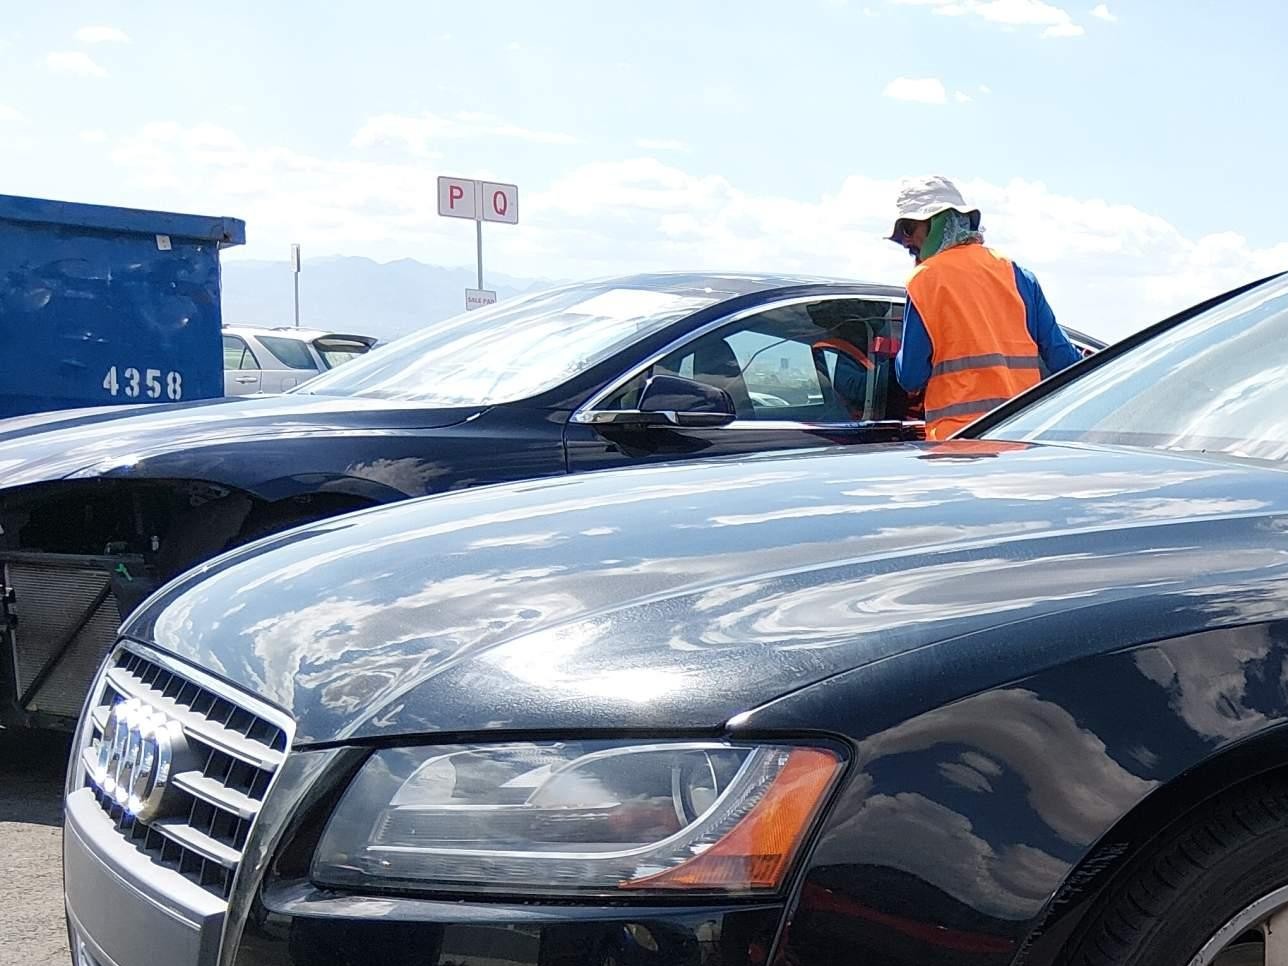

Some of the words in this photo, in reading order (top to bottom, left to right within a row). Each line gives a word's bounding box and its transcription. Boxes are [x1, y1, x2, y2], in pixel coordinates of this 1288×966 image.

[449, 185, 464, 209] P
[493, 190, 508, 216] Q
[103, 366, 182, 400] 4358
